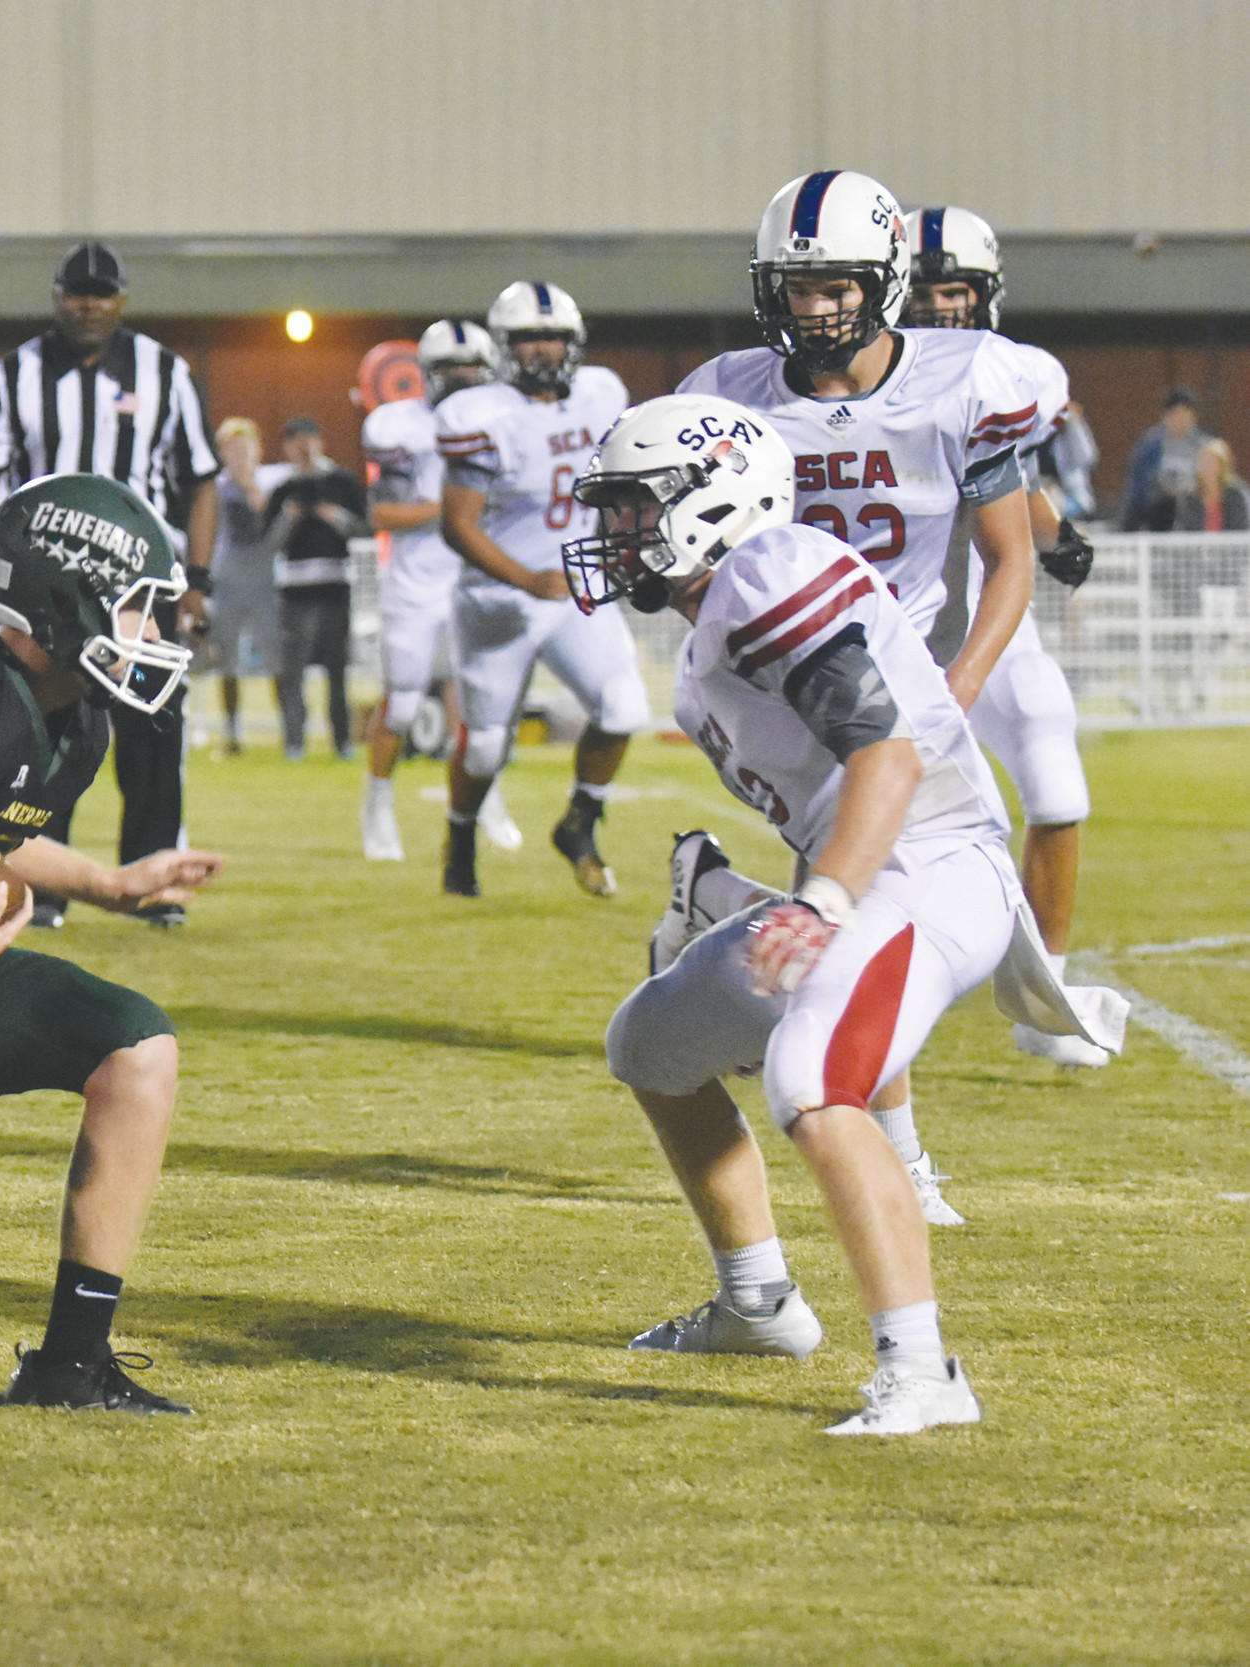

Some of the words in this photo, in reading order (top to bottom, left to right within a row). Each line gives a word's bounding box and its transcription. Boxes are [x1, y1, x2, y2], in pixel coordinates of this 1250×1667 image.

[547, 427, 594, 456] SCA
[677, 416, 752, 451] SCA
[795, 450, 899, 491] SCA
[545, 464, 589, 531] 6
[29, 502, 149, 573] GENERALS
